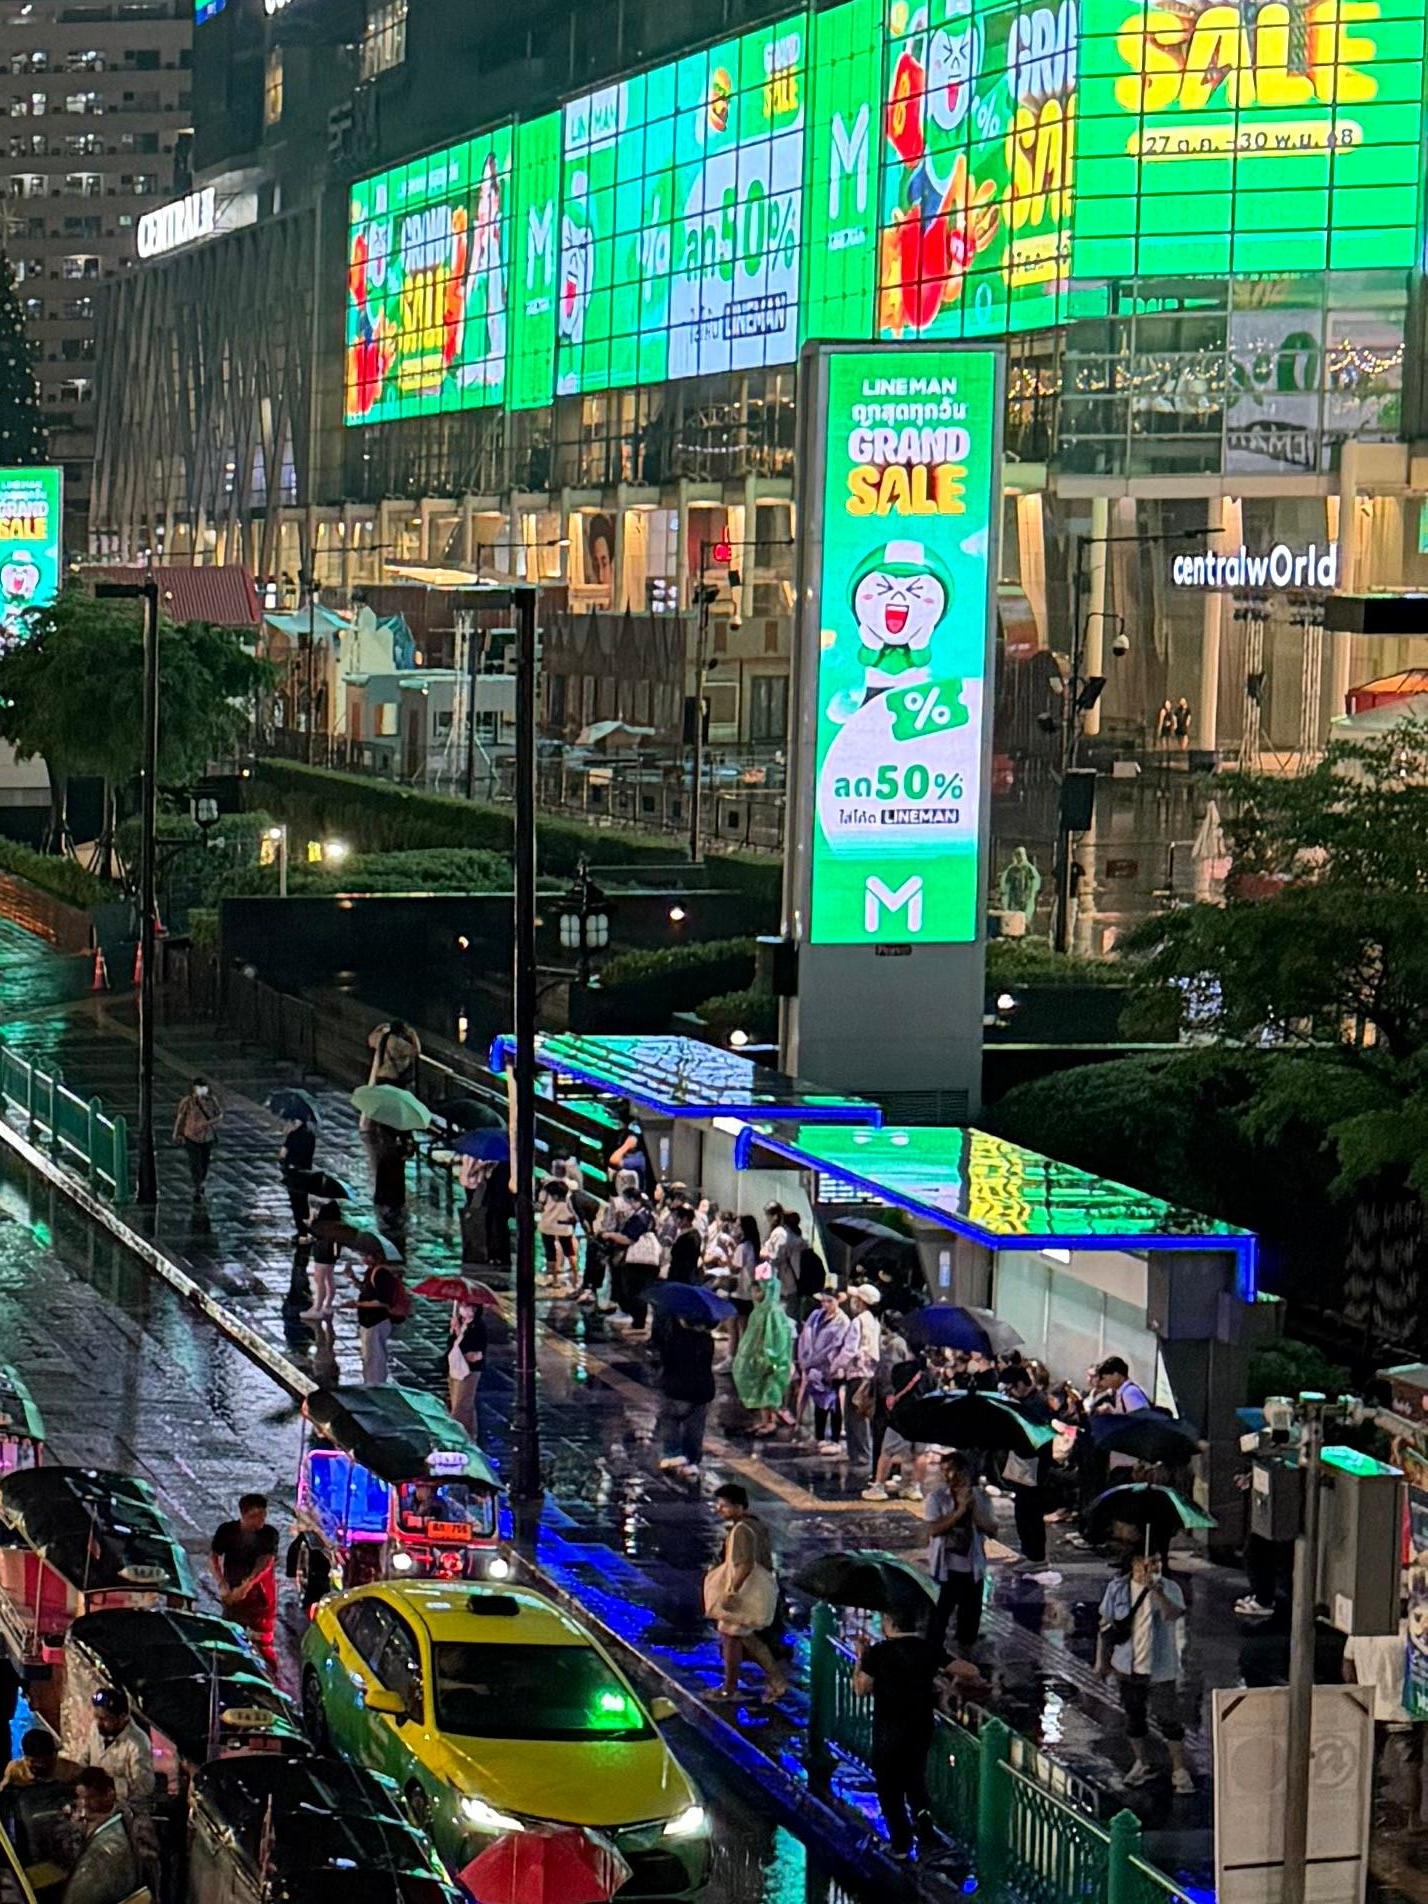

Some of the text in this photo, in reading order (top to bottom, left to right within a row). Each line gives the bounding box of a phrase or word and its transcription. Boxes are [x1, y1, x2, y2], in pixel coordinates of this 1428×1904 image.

[1115, 1, 1380, 114] SALE
[829, 102, 870, 220] M
[848, 427, 970, 464] GRAND
[846, 464, 968, 517] SALE
[885, 809, 959, 824] LINEMAN
[864, 875, 923, 933] M
